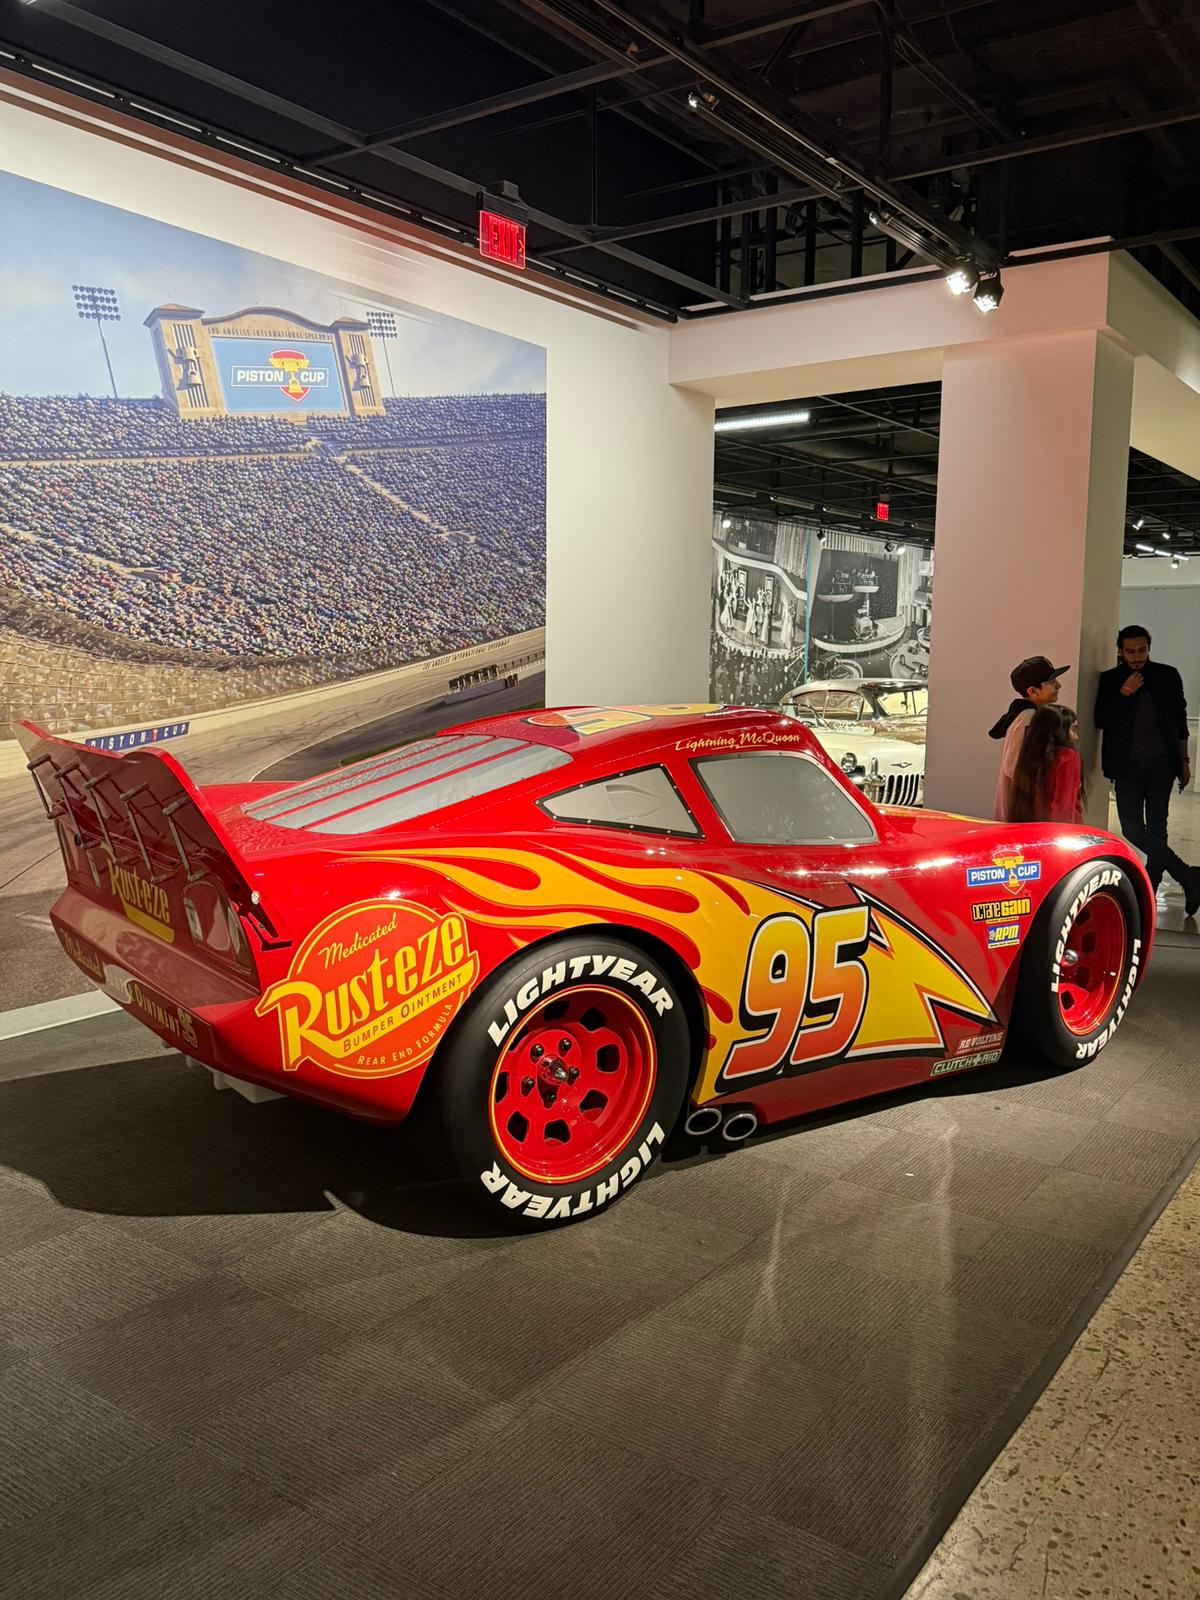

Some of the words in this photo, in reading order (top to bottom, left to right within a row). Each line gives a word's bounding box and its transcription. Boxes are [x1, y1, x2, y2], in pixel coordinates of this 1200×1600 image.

[489, 215, 519, 262] EXIT
[236, 369, 284, 383] PISTON
[300, 371, 325, 384] CUP
[164, 723, 186, 738] CUP
[675, 737, 737, 752] Lightning
[970, 869, 1006, 882] PISTON
[1017, 865, 1038, 877] CUP
[317, 911, 398, 971] Medicated
[1051, 869, 1123, 994] LIGHTYEAR
[342, 1015, 395, 1053] BUMPER
[400, 973, 463, 1019] OINTMENT
[487, 954, 675, 1048] LIGHTYEAR
[716, 904, 871, 1092] 95
[1075, 938, 1142, 1060] LIGHTYEAR
[357, 1055, 387, 1066] REAR
[392, 1047, 414, 1062] END
[415, 1002, 454, 1049] FORMULA
[933, 1056, 973, 1074] CLUTCH
[980, 1052, 999, 1064] AID
[480, 1121, 666, 1220] LIGHTYEAR
